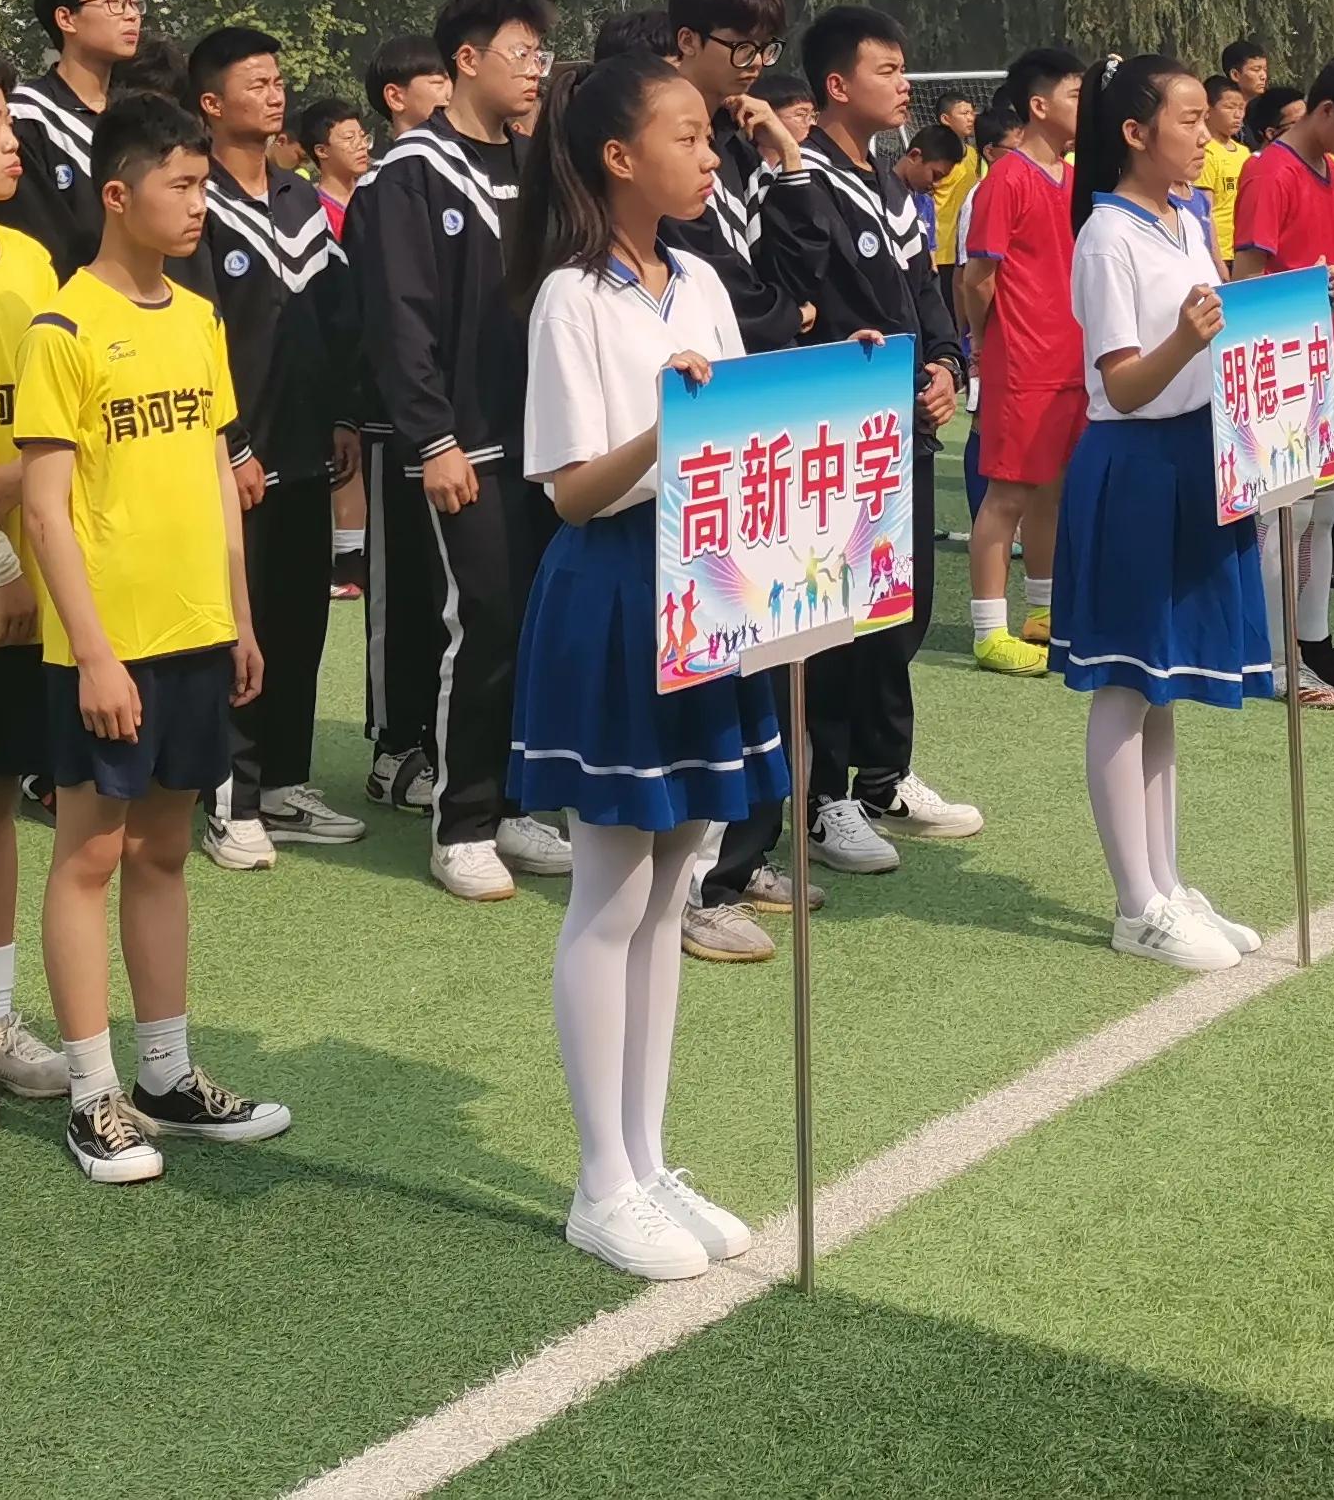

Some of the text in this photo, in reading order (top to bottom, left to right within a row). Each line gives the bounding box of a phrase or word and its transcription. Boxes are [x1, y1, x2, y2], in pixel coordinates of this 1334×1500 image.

[1221, 325, 1330, 428] 明德二中
[678, 410, 902, 562] 高新中学
